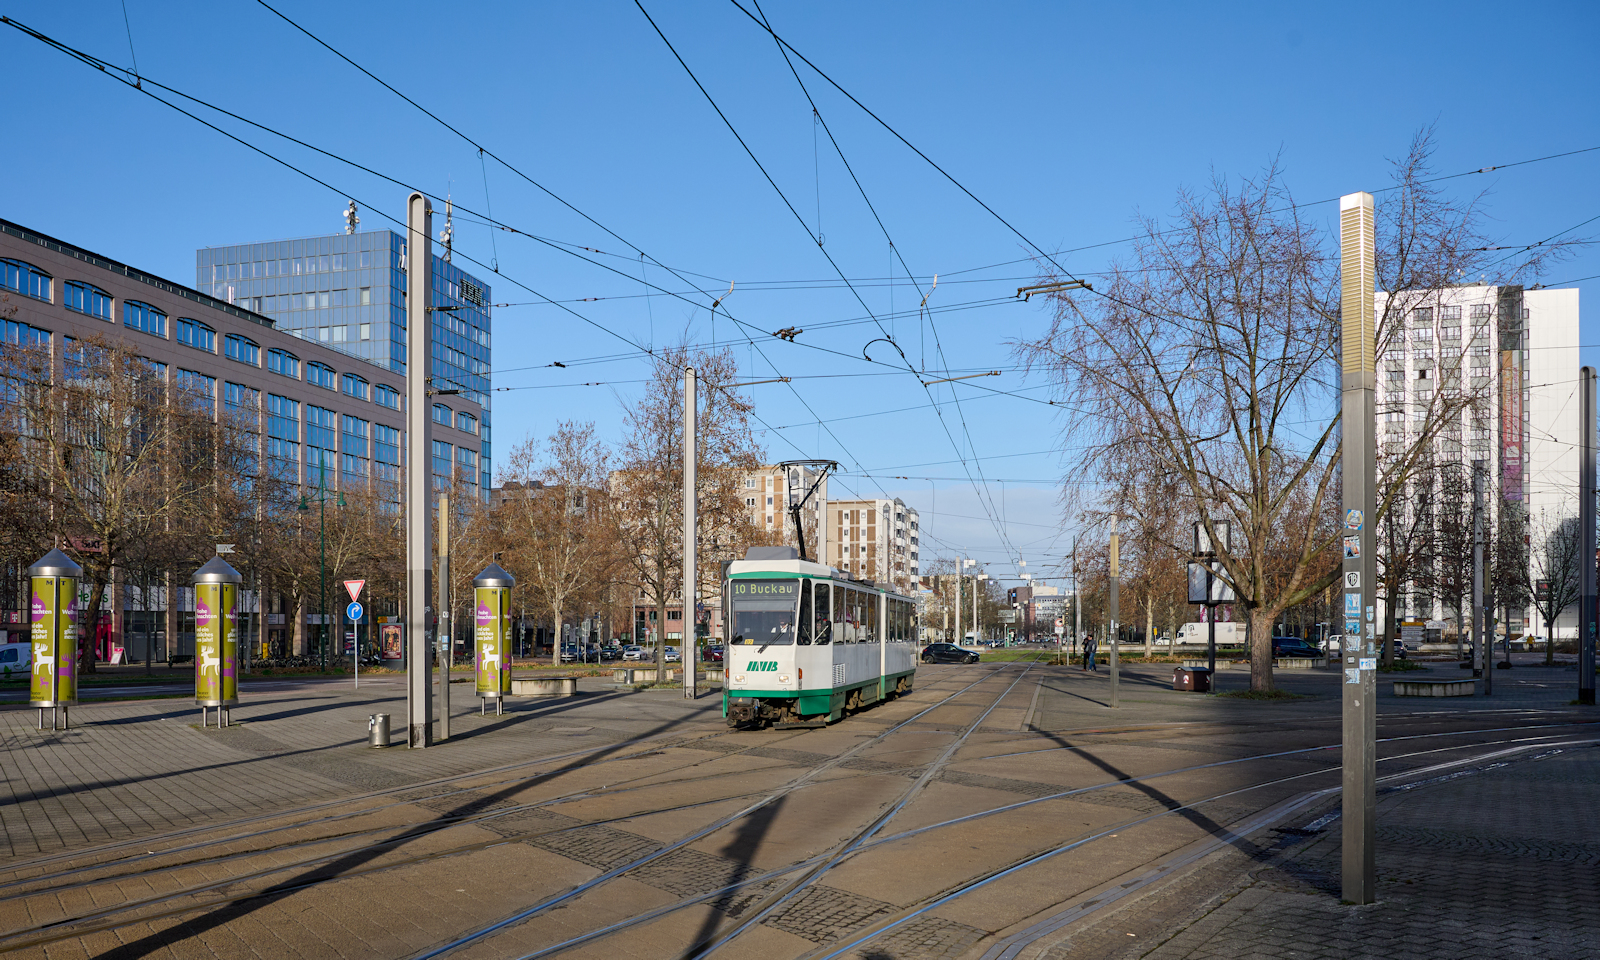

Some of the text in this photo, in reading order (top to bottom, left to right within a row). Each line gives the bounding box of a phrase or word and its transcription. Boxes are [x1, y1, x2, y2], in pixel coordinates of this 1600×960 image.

[735, 584, 792, 594] 10 Buckau
[746, 661, 778, 672] MVB
